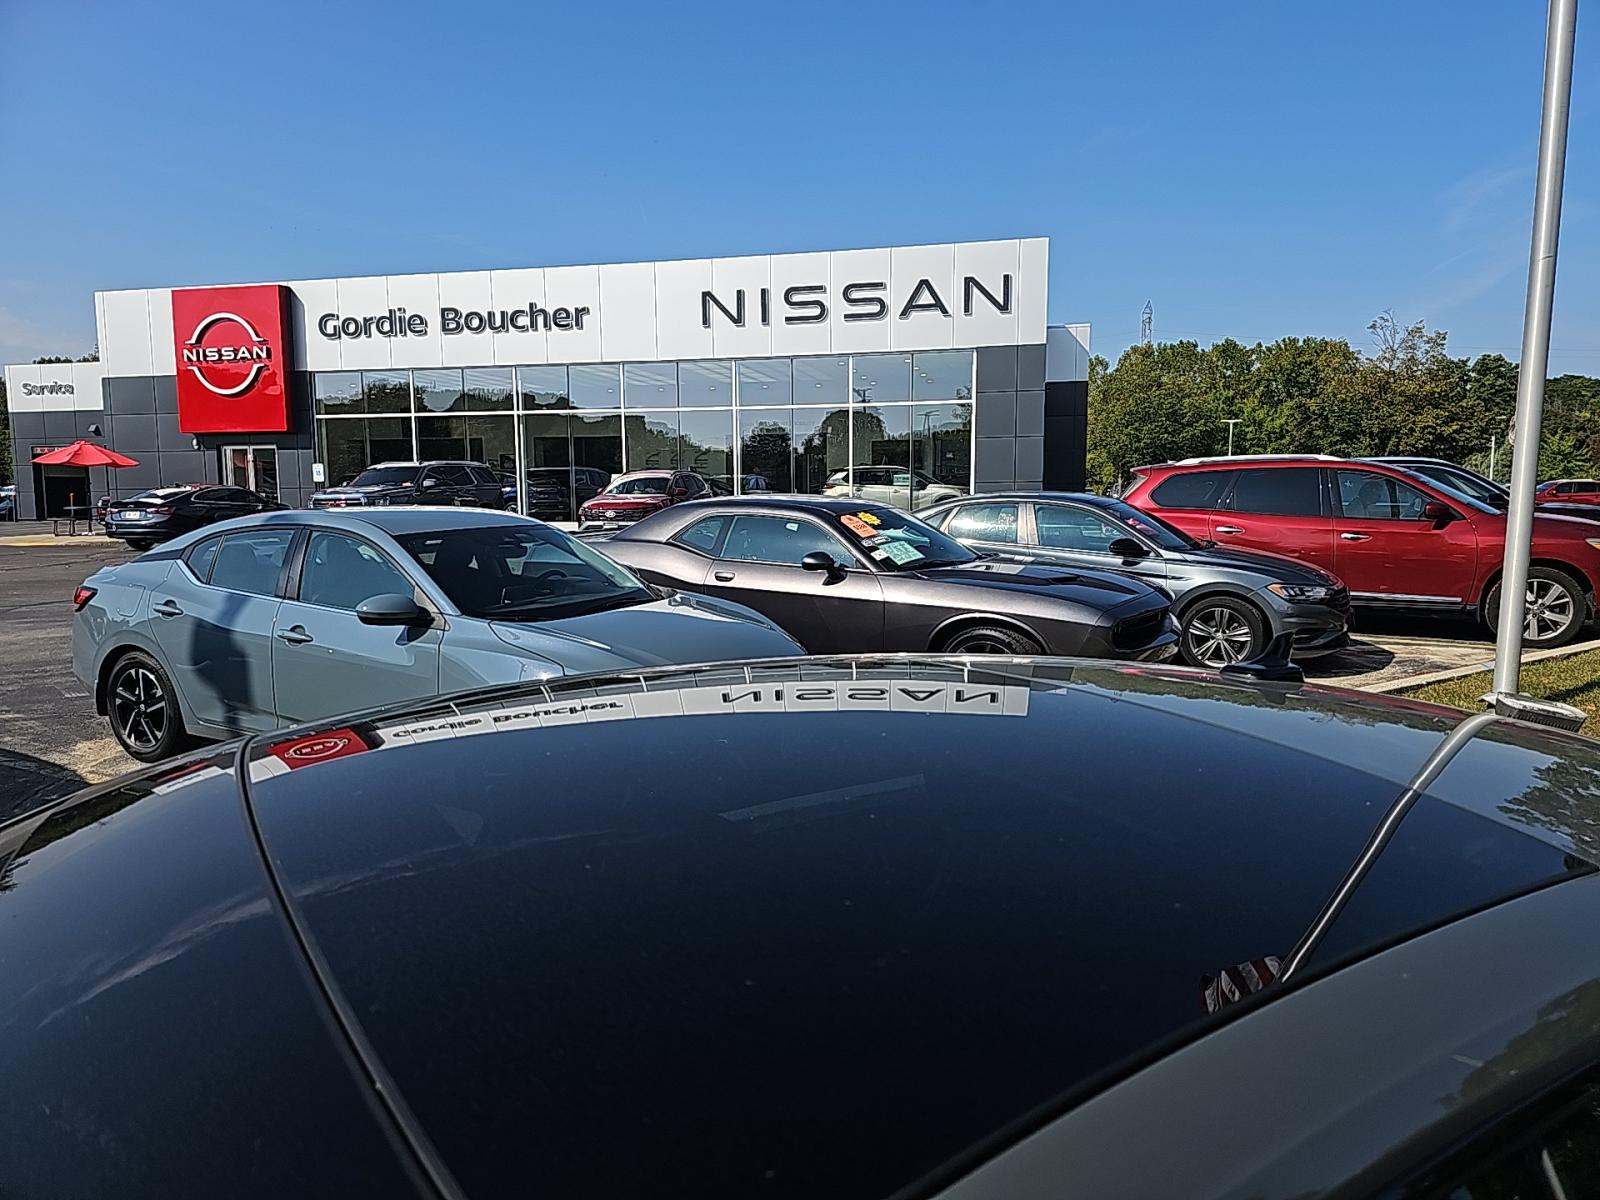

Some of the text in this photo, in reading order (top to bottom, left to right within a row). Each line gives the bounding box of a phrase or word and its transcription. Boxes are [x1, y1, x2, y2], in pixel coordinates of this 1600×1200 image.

[701, 273, 1013, 328] NISSAN
[318, 302, 590, 340] Gordie Boucher
[183, 345, 270, 363] NISSAN
[22, 381, 75, 396] Service
